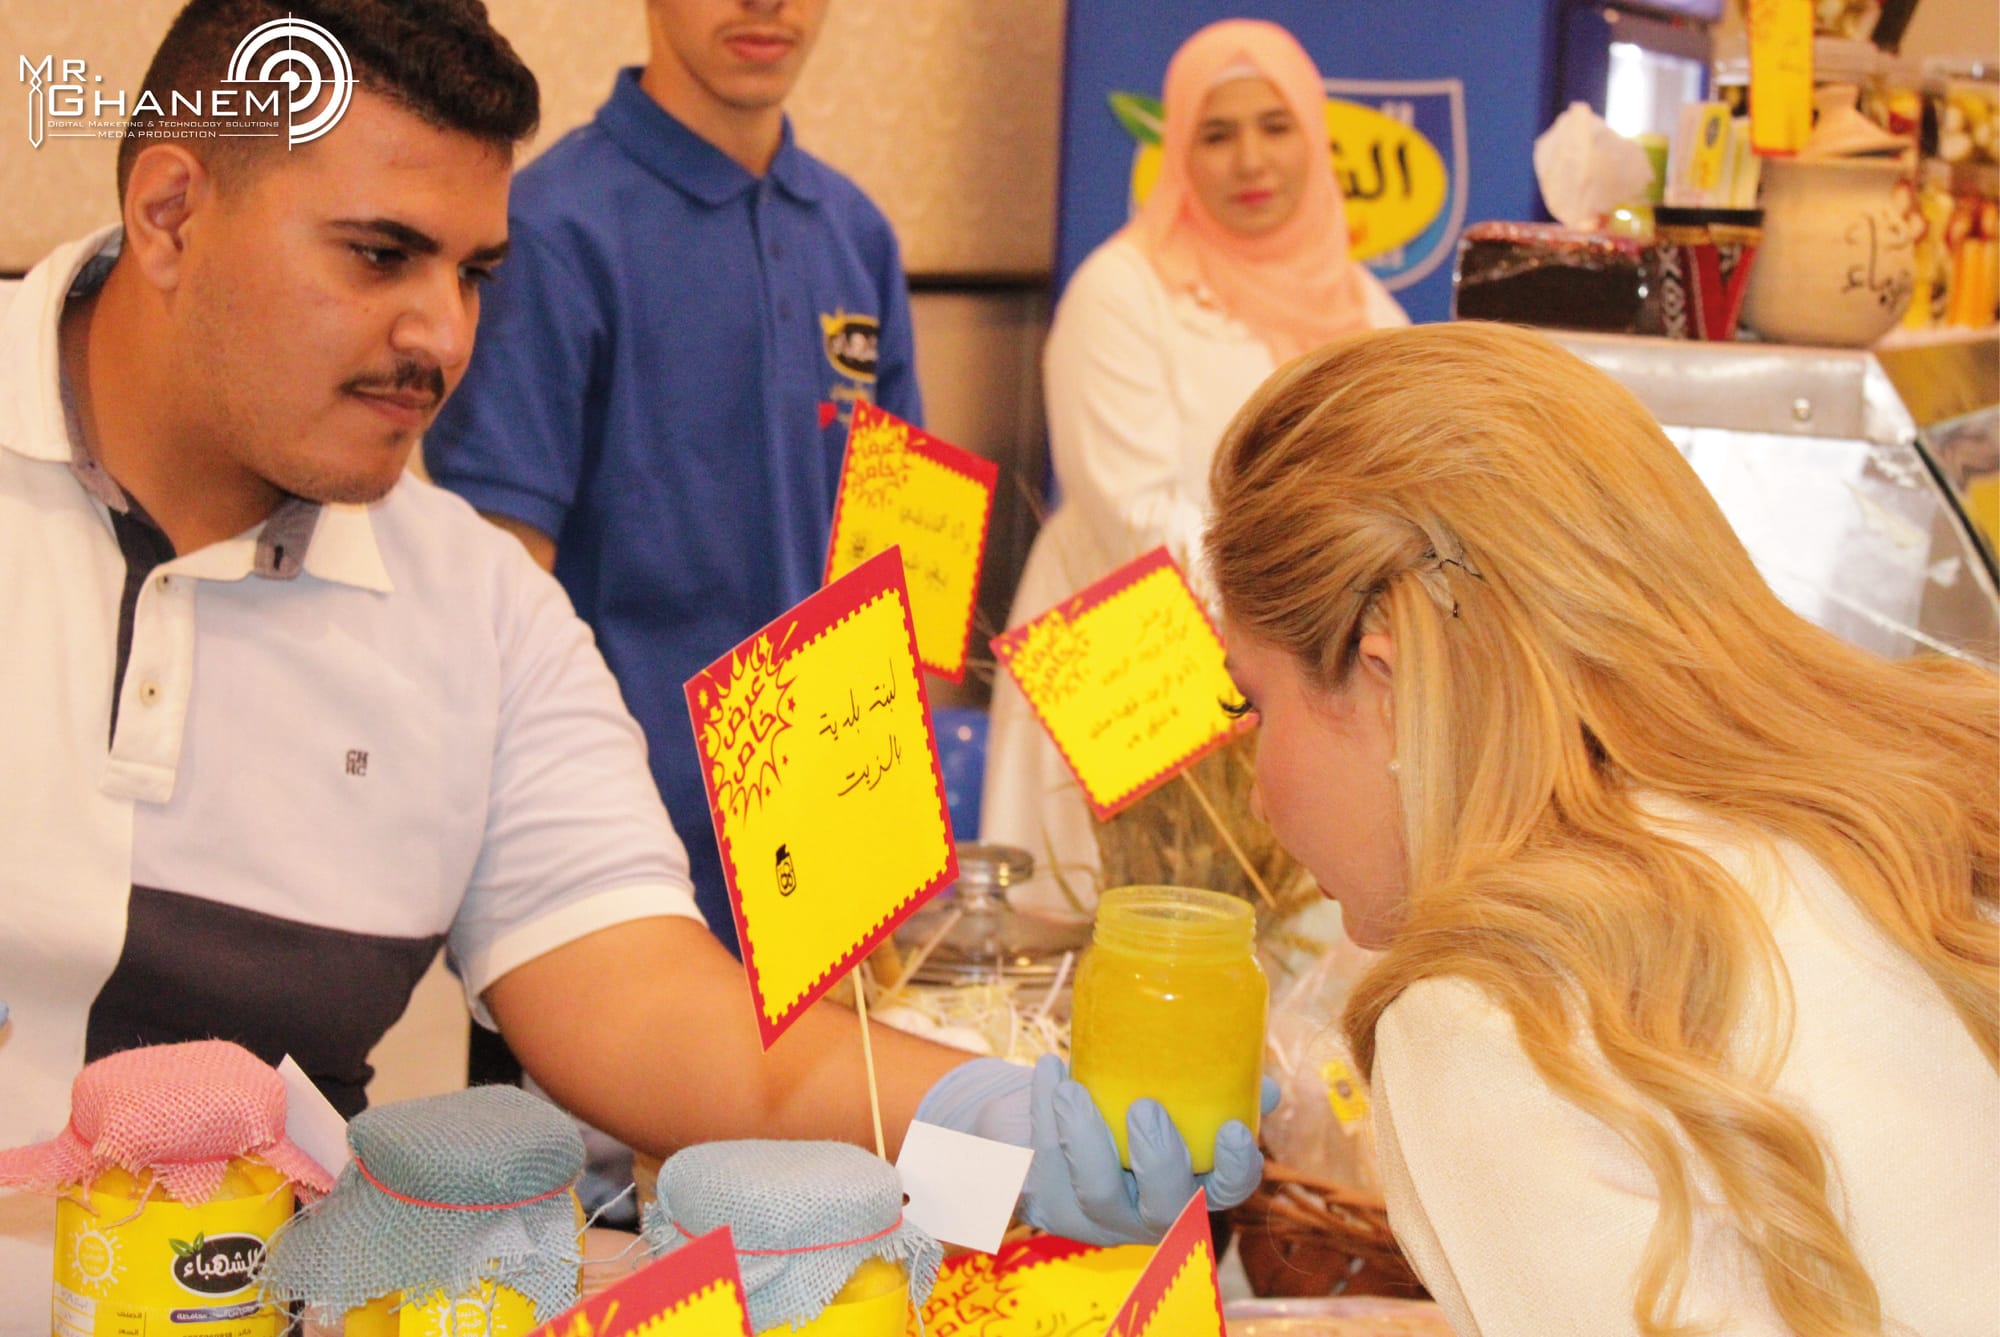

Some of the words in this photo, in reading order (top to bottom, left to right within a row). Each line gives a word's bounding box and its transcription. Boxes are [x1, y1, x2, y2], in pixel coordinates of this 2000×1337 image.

[723, 674, 766, 750] عرض
[819, 687, 860, 741] بلدية
[733, 709, 777, 784] خاص
[837, 733, 902, 797] بالزيت
[183, 1247, 259, 1281] الشهباء
